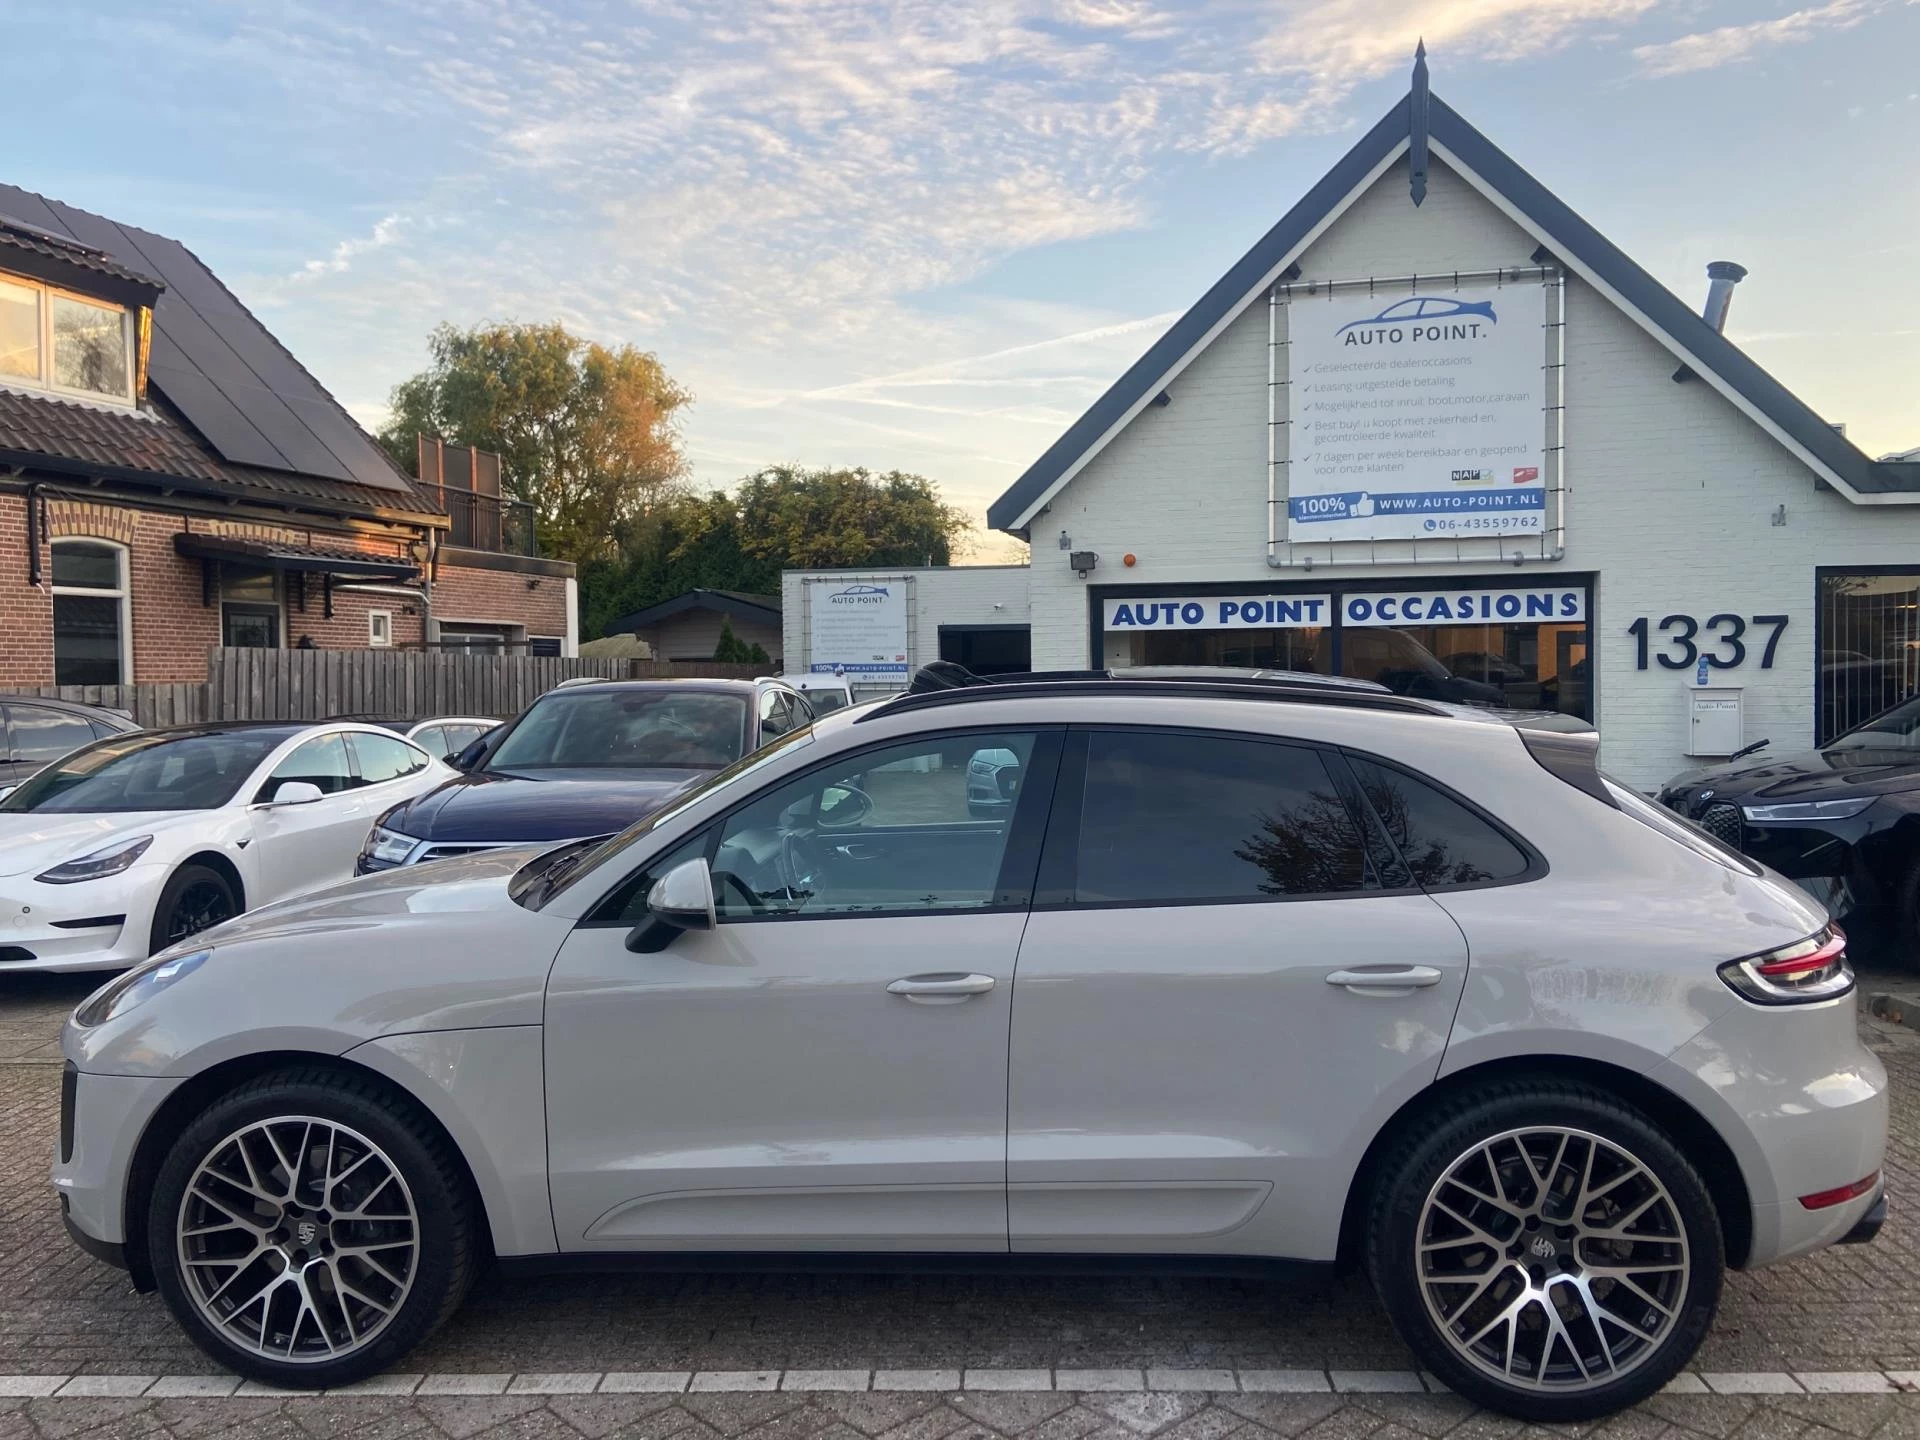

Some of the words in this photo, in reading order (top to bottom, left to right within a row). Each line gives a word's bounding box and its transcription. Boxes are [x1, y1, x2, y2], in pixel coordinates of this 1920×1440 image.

[1344, 329, 1403, 346] AUTO
[1412, 324, 1487, 342] POINT.
[1314, 359, 1387, 374] Geselecteerde
[1389, 355, 1473, 370] dealeroccasions
[1314, 379, 1353, 393] Leasing
[1356, 376, 1412, 391] uitgestelde
[1413, 374, 1456, 388] betaling
[1314, 398, 1377, 413] Mogelijkheid
[1380, 397, 1395, 408] tot
[1314, 420, 1337, 432] Best
[1372, 417, 1402, 431] koopt
[1404, 416, 1425, 427] met
[1427, 412, 1478, 425] zekerheid
[1314, 430, 1392, 446] gecontroleerde
[1394, 428, 1436, 441] kwaliteit
[1314, 452, 1321, 463] 7
[1323, 450, 1355, 465] dagen
[1357, 451, 1375, 464] per
[1377, 448, 1404, 460] week
[1405, 445, 1462, 459] bereikbaar
[1464, 446, 1478, 457] en
[1480, 443, 1527, 458] geopend
[1314, 465, 1336, 476] voor
[1338, 463, 1365, 474] onze
[1366, 460, 1405, 473] klanten
[1452, 469, 1480, 481] NAP
[1298, 496, 1347, 515] 100%
[1379, 494, 1539, 510] WWW.AUTO-POINT.NL
[1438, 516, 1539, 531] 06-43559762
[1111, 603, 1204, 626] AUTO
[1218, 599, 1325, 624] POINT
[1347, 592, 1580, 622] OCCASIONS
[1627, 614, 1789, 671] 1337
